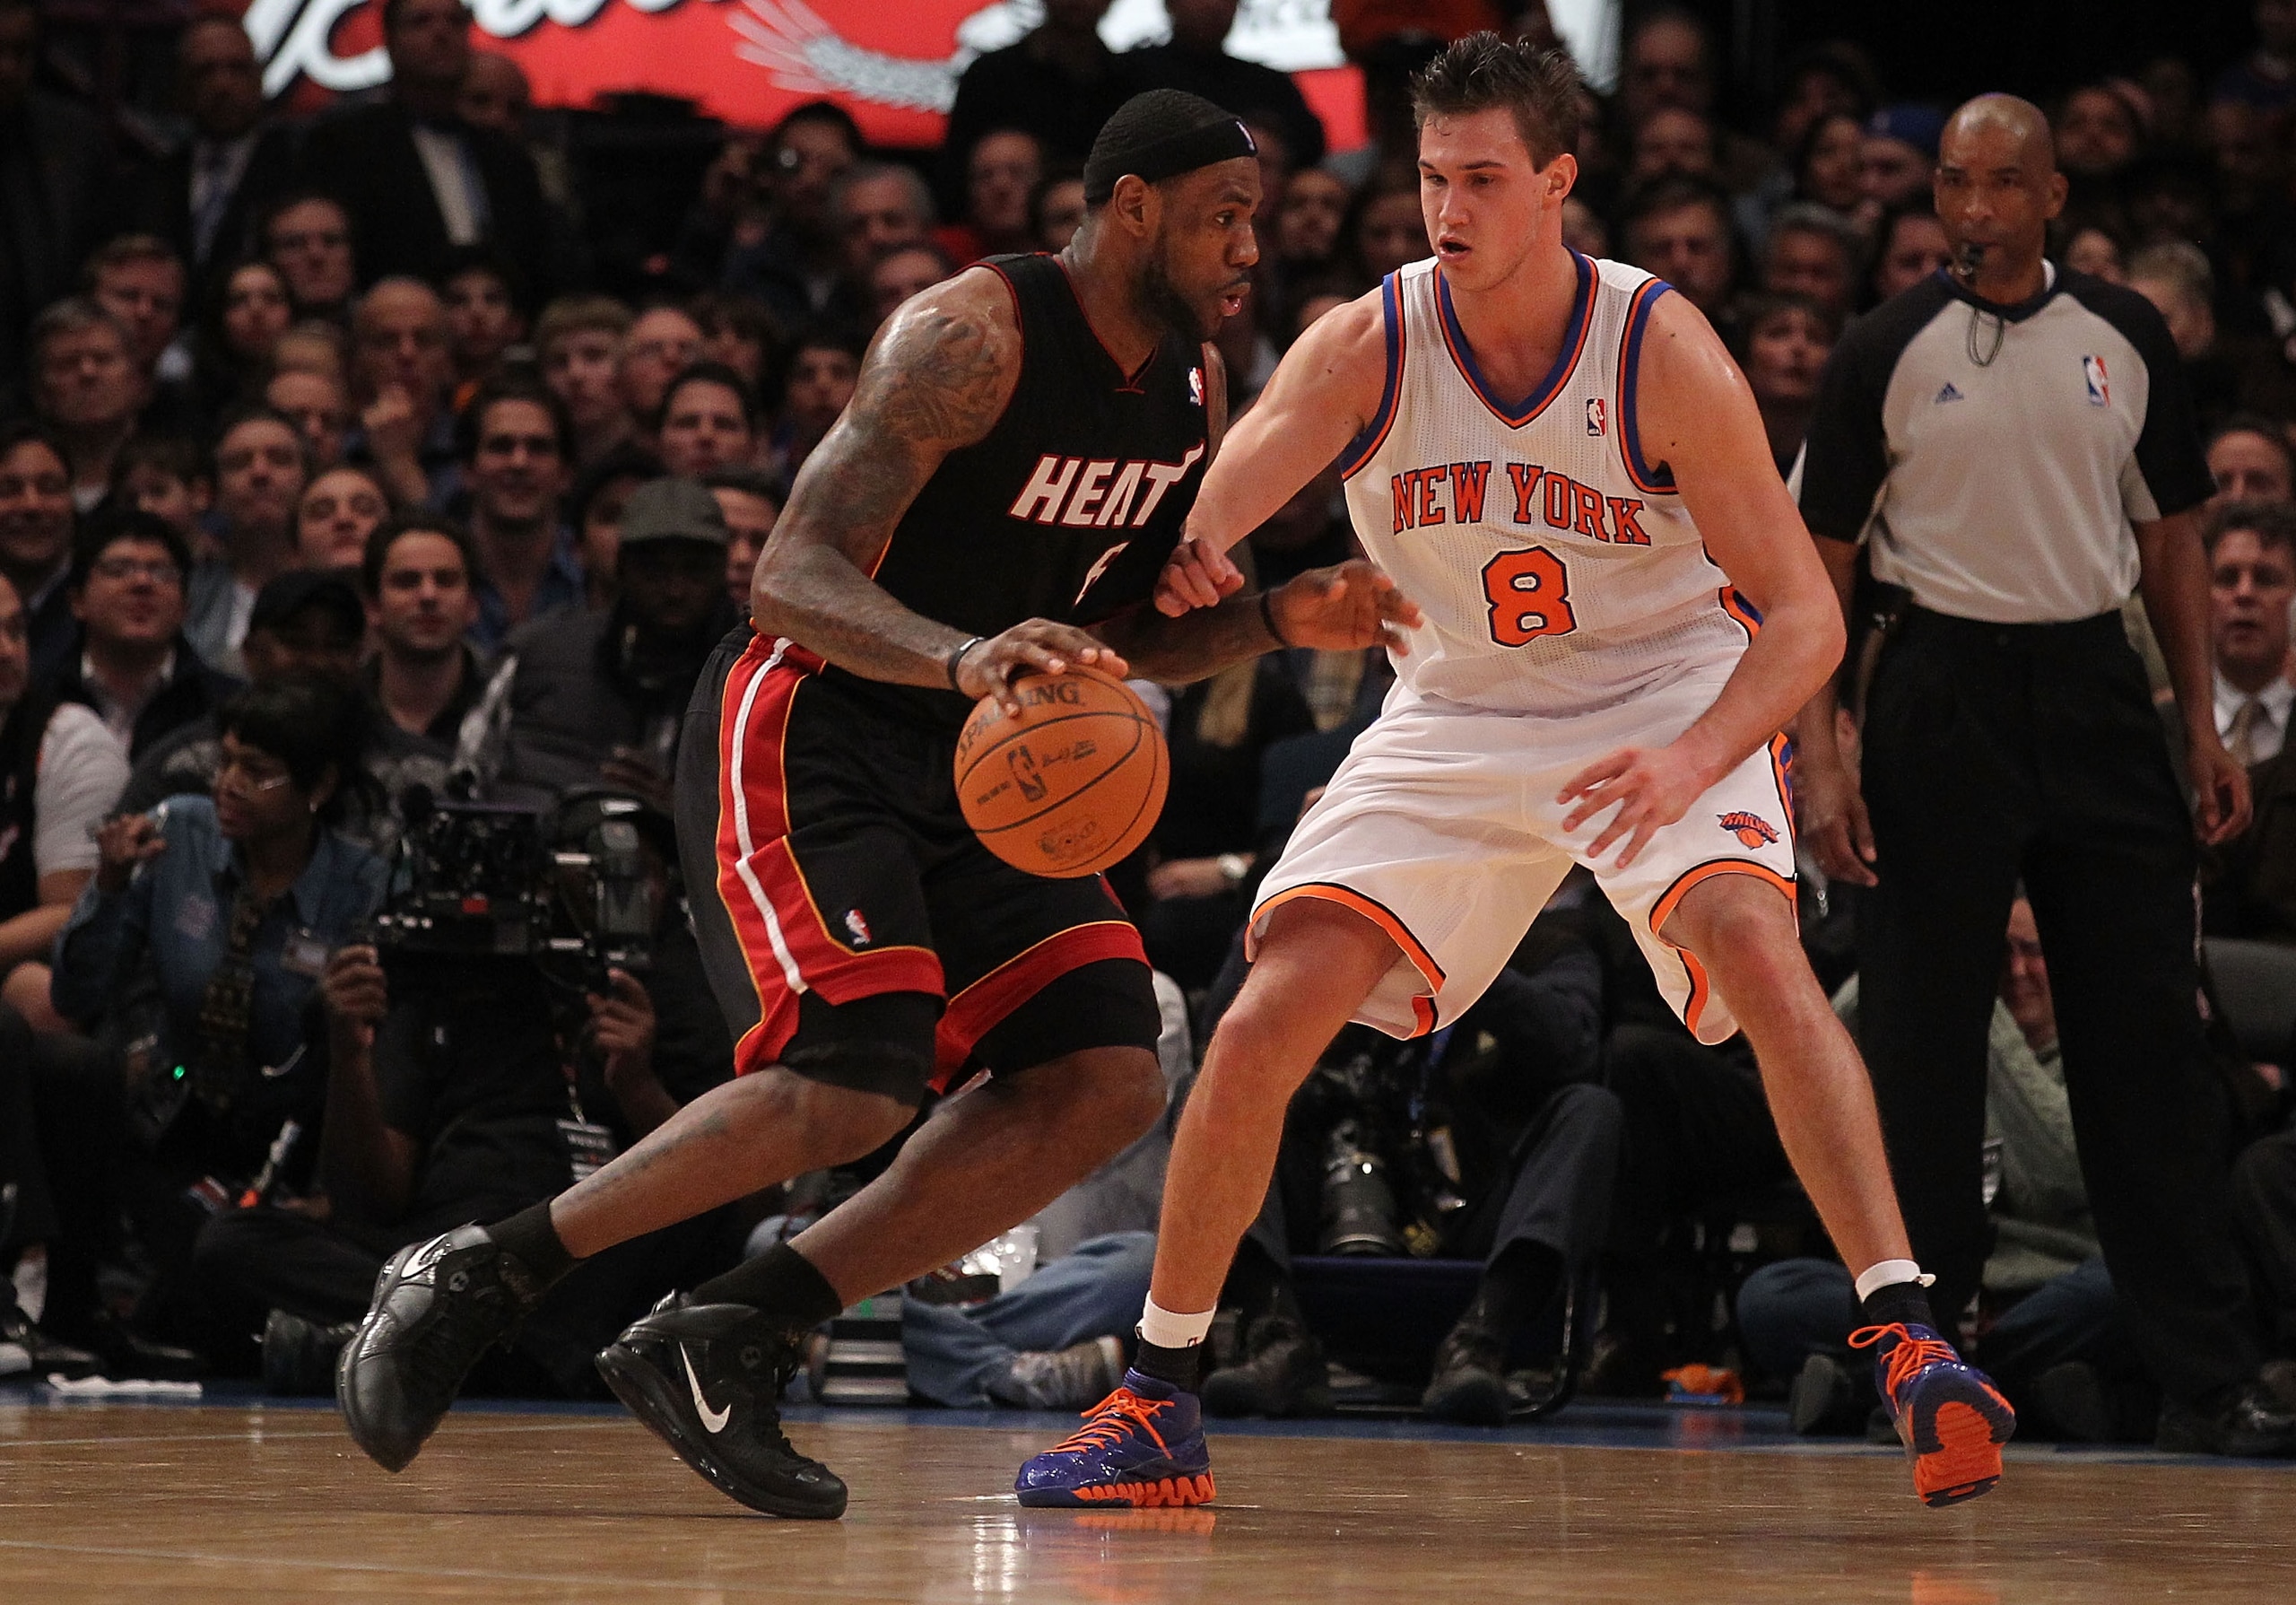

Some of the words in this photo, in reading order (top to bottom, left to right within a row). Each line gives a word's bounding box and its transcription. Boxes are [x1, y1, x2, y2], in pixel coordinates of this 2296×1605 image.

[1008, 438, 1205, 528] HEAT
[1391, 460, 1492, 536] NEW
[1507, 462, 1651, 546] YORK
[1482, 545, 1578, 648] 8
